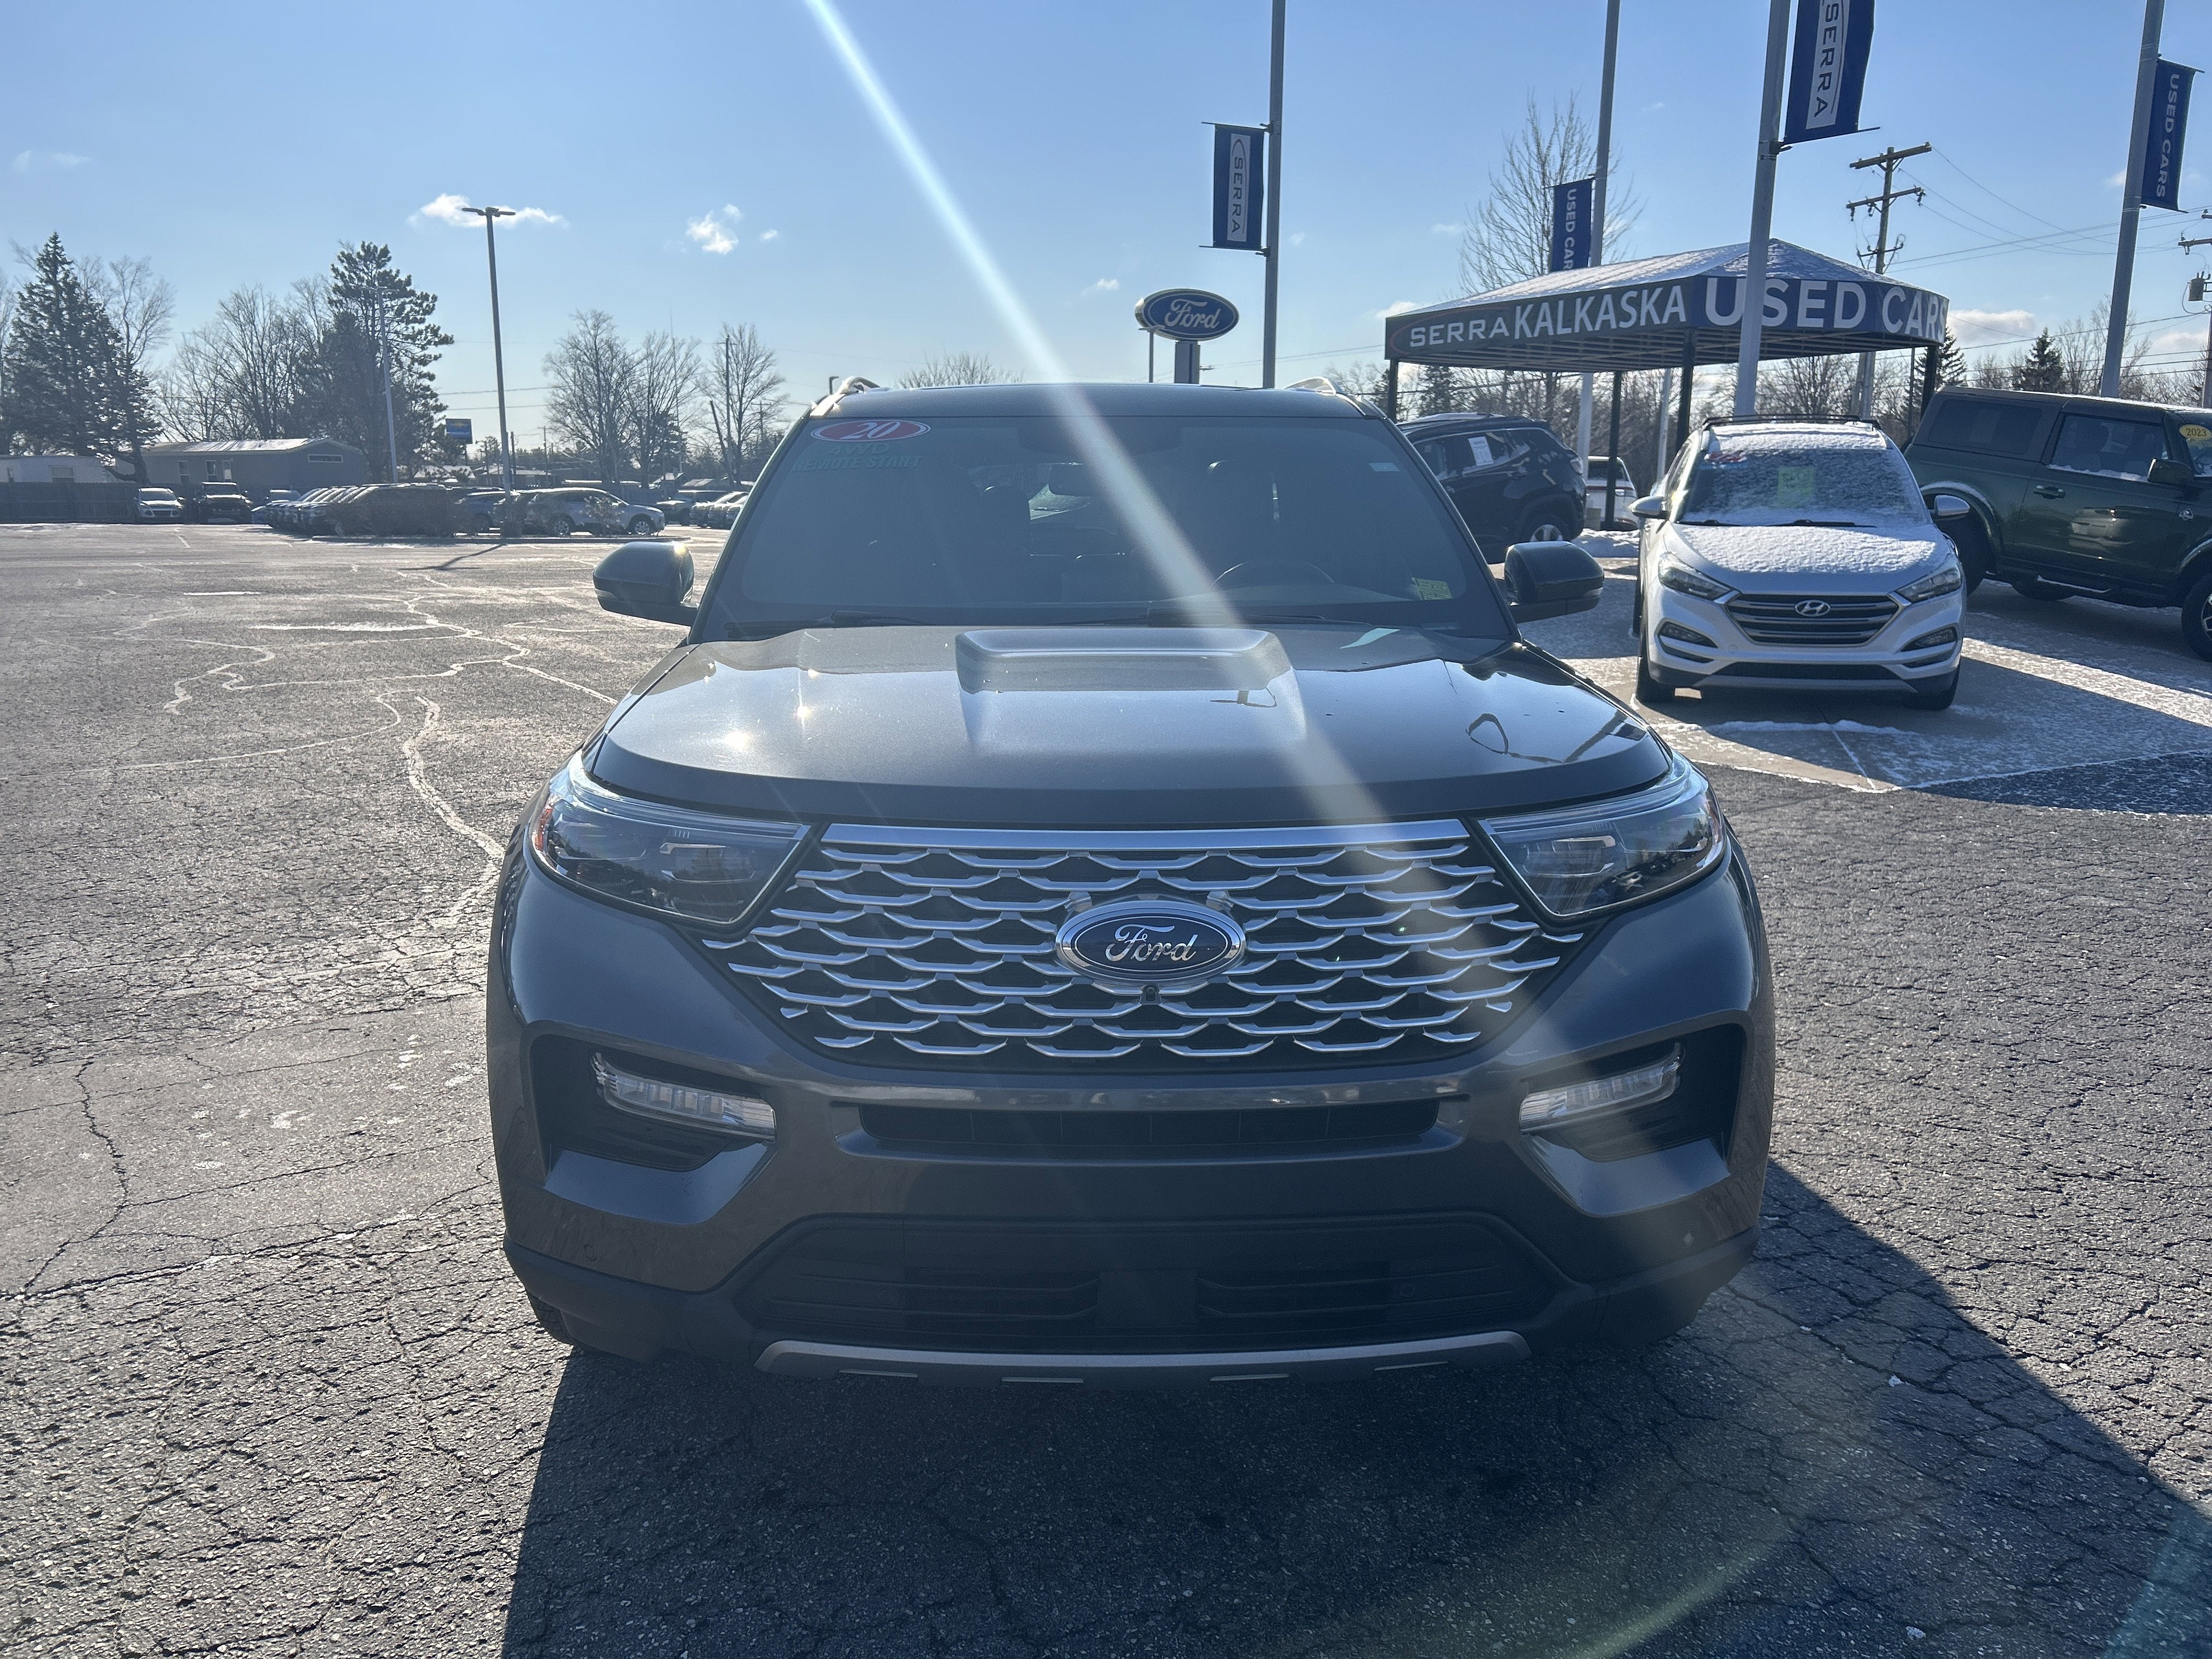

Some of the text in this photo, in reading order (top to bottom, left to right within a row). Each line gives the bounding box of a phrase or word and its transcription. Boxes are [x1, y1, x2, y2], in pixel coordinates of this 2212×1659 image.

[1814, 3, 1839, 117] SERRA
[2156, 74, 2180, 198] USED CARS
[1231, 156, 1244, 233] SERRA
[1565, 188, 1577, 233] USED
[1164, 298, 1222, 329] Ford
[1409, 285, 1687, 347] SERRA KALKASKA
[1705, 277, 1948, 343] USED CARS
[828, 443, 890, 456] 4WD
[839, 421, 901, 439] 20
[2186, 427, 2207, 437] 2023
[864, 455, 923, 469] START
[1104, 923, 1199, 962] Ford
